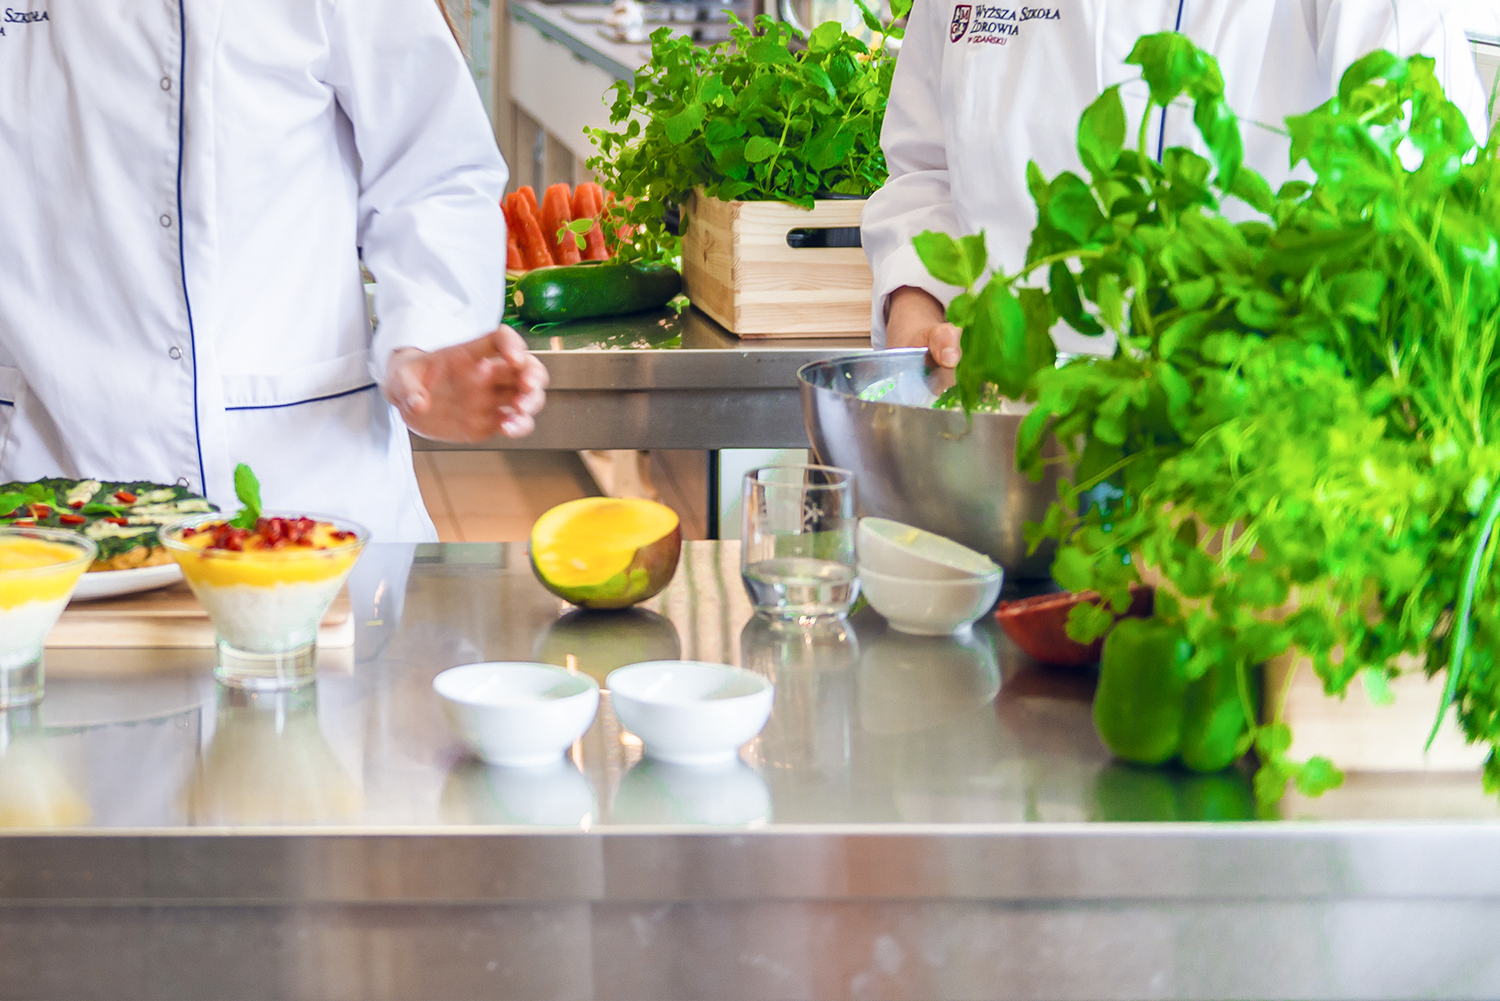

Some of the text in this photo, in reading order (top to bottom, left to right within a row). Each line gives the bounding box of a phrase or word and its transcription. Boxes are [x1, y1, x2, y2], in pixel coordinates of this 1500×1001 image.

[975, 4, 1061, 22] WYŻSZA SZKOŁA
[970, 19, 1019, 36] ZDROWIA
